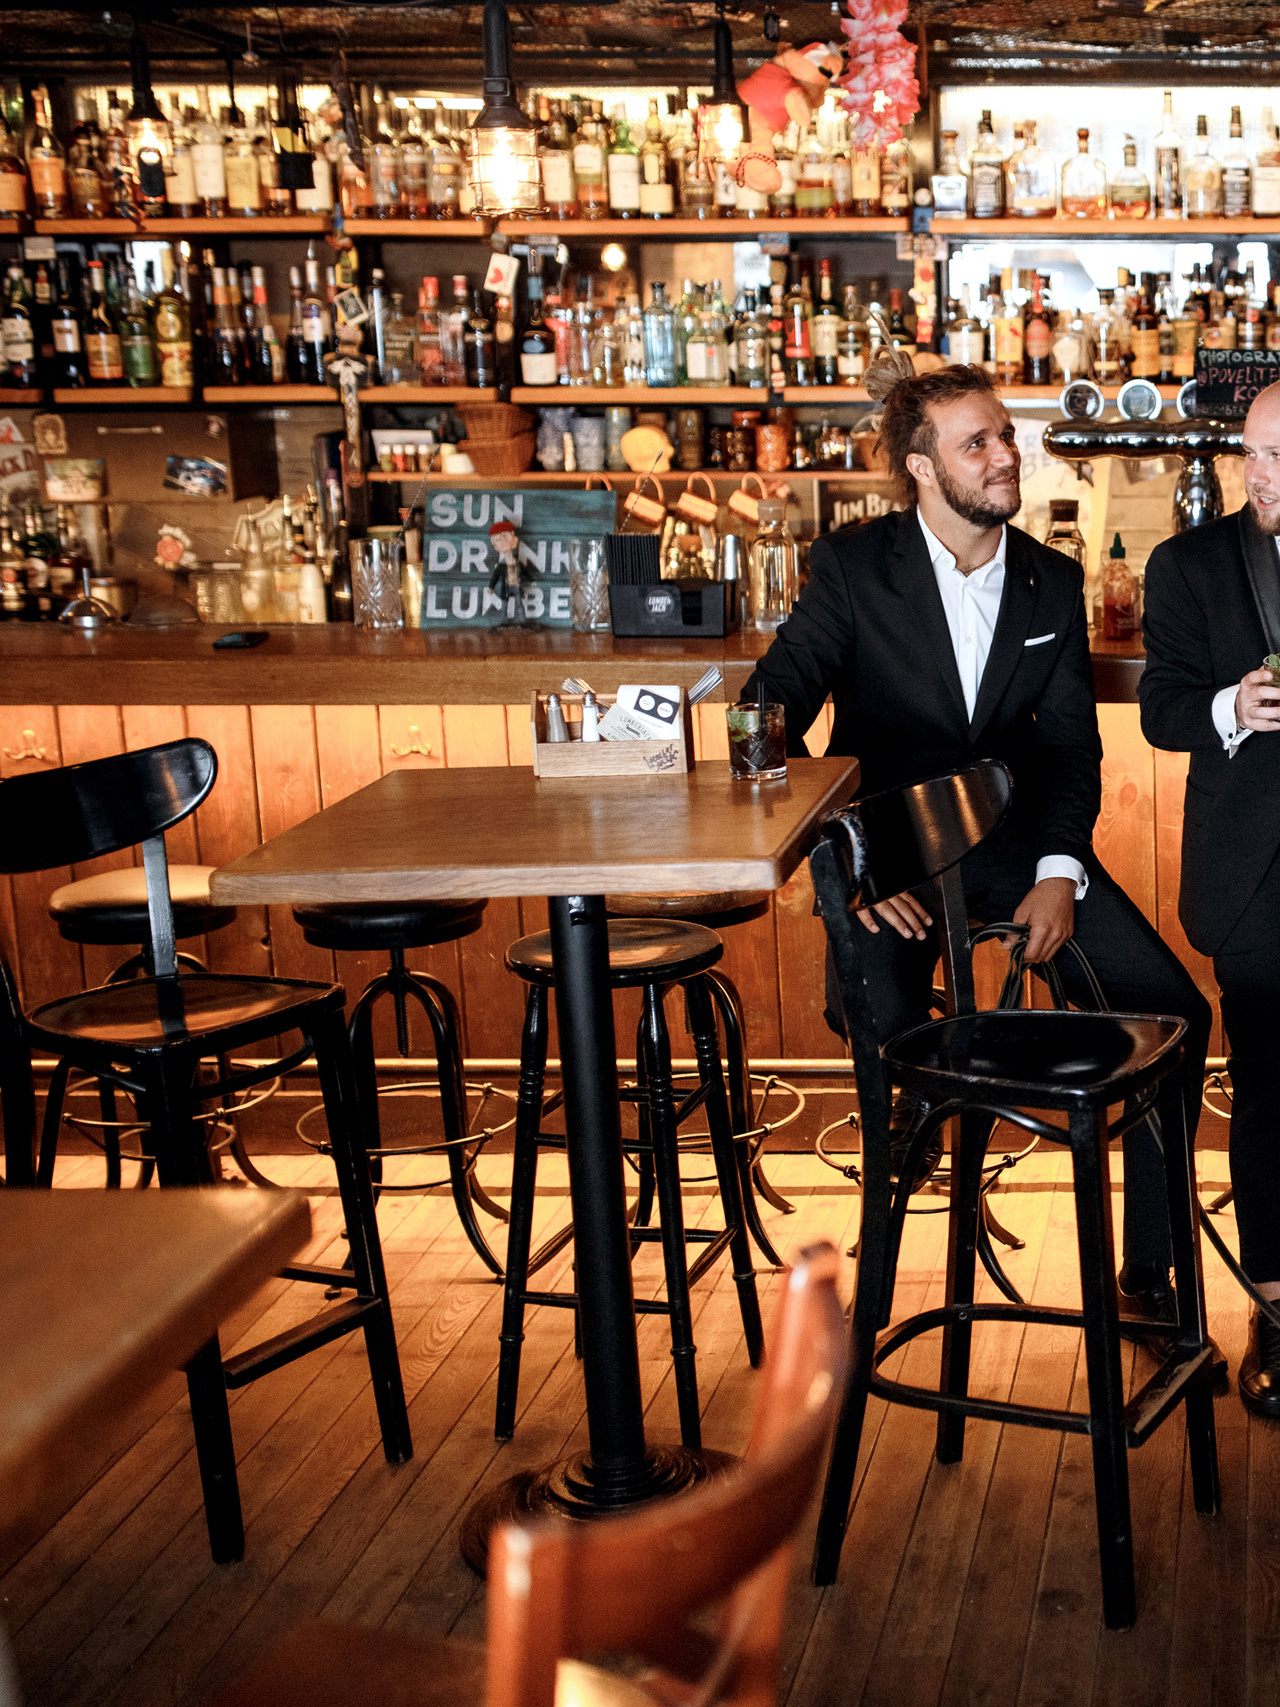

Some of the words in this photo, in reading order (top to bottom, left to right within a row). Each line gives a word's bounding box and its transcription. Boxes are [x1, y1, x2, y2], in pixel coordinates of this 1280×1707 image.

[431, 493, 523, 528] SUN
[829, 500, 865, 533] JIM
[428, 539, 581, 574] DRNK
